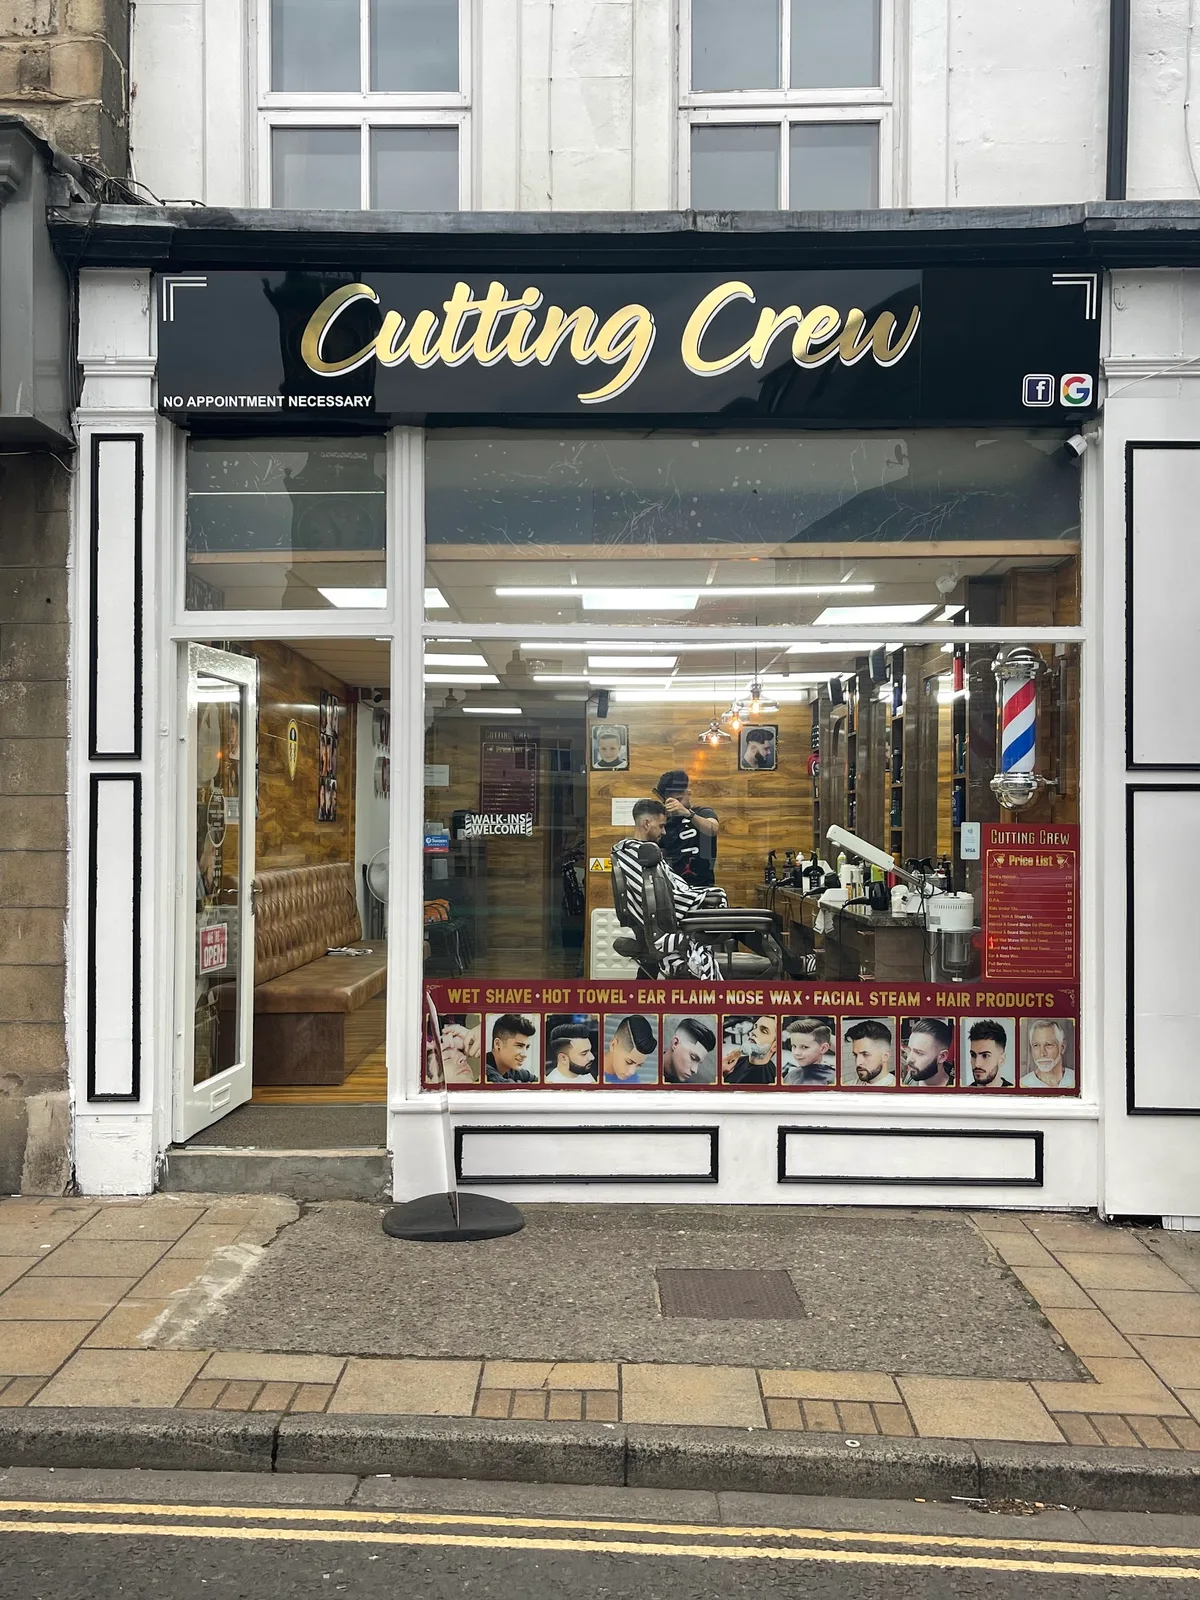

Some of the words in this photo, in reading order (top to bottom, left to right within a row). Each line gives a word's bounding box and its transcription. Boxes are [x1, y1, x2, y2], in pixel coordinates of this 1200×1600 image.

[301, 280, 656, 404] Cutting
[681, 280, 921, 377] Crew
[163, 396, 183, 408] NO
[186, 396, 284, 408] APPOINTMENT
[287, 395, 372, 408] NECESSARY
[471, 813, 526, 824] WALK-INS
[471, 824, 526, 835] WELCOME
[991, 828, 1035, 845] CUTTING
[1039, 829, 1070, 845] CREW
[1008, 854, 1034, 867] Price
[1035, 855, 1053, 867] List
[204, 943, 224, 967] OPEN
[447, 988, 479, 1004] WET
[486, 988, 532, 1004] SHAVE
[542, 989, 571, 1004] HOT
[577, 989, 627, 1005] TOWEL
[638, 989, 666, 1005] EAR
[671, 989, 716, 1005] FLAIM
[726, 990, 763, 1006] NOSE
[769, 990, 803, 1006] WAX
[813, 991, 864, 1007] FACIAL
[869, 991, 921, 1007] STEAM
[936, 992, 970, 1008] HAIR
[976, 992, 1054, 1008] PRODUCTS
